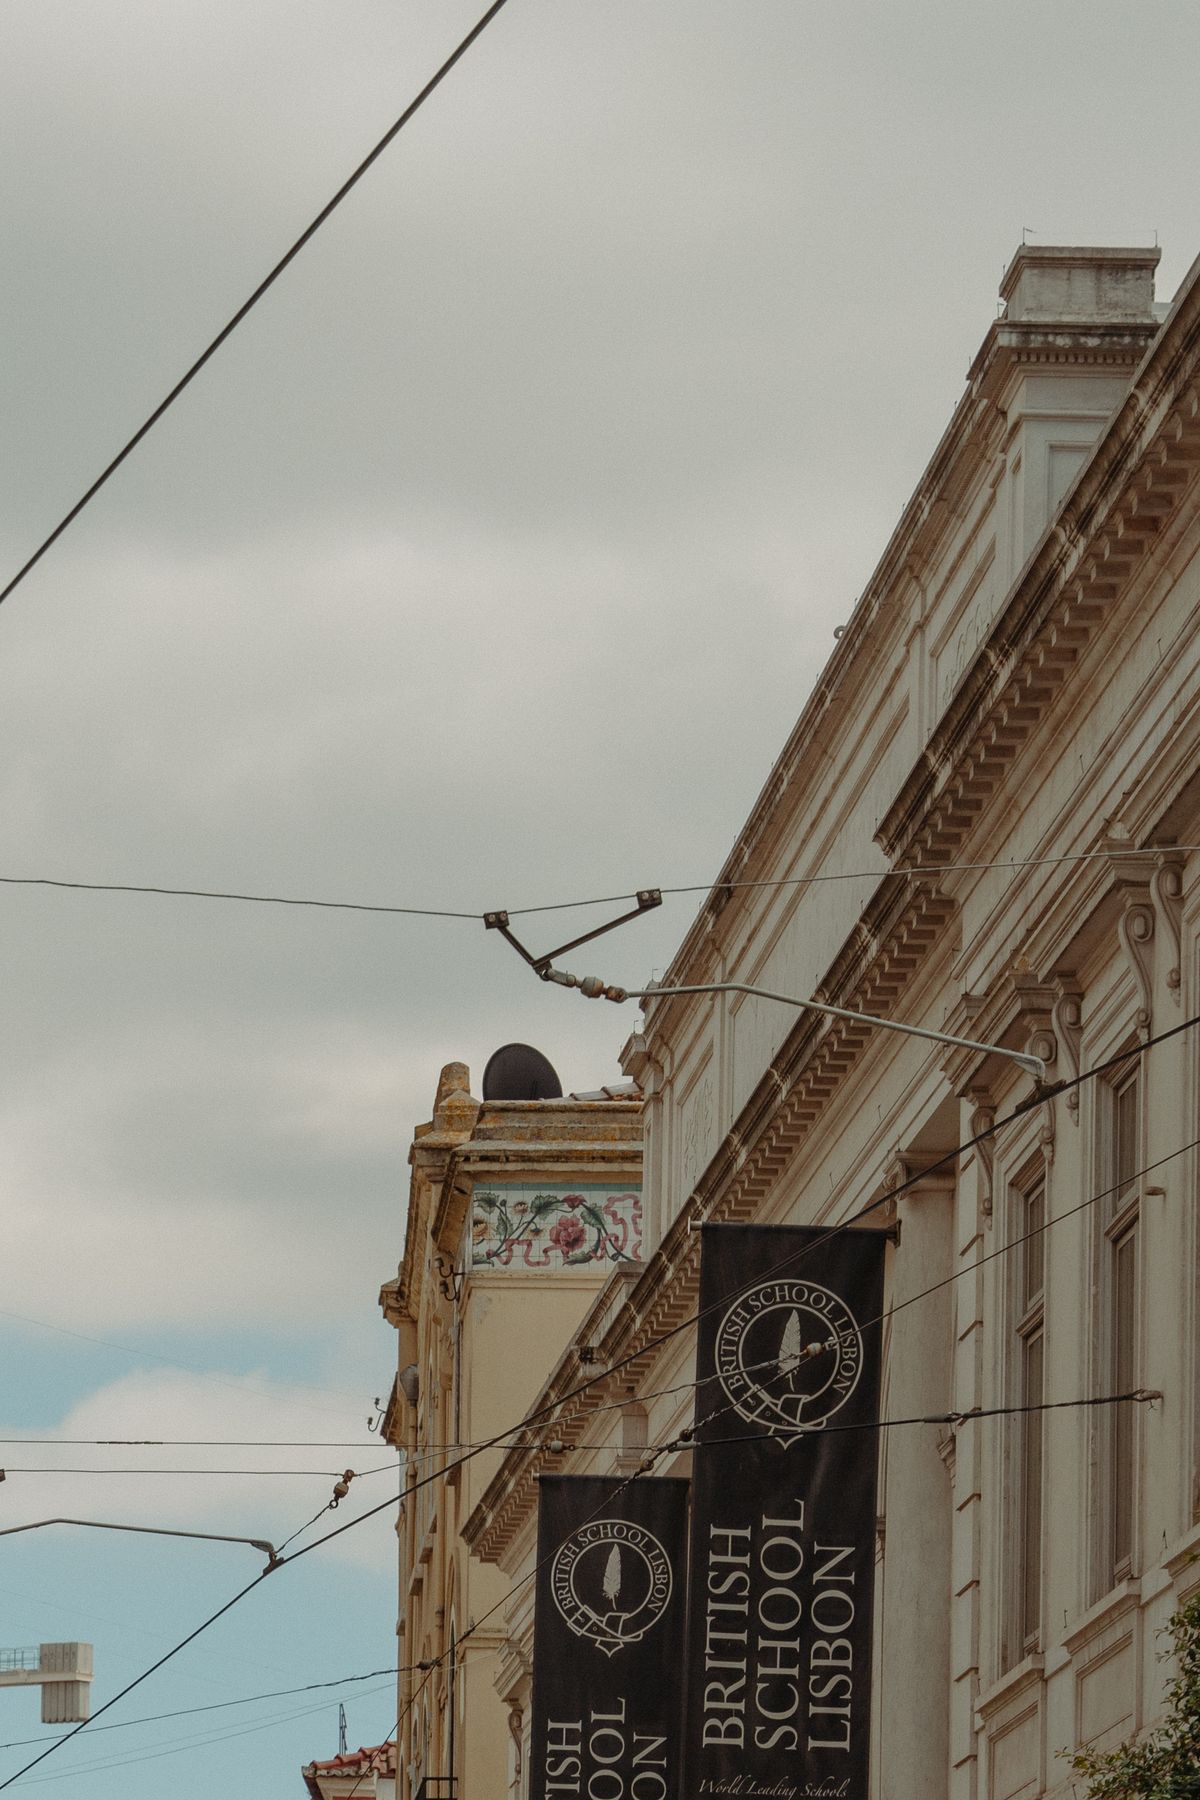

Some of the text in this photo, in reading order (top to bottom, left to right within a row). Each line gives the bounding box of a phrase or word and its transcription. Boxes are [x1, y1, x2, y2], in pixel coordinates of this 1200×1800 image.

[719, 1284, 858, 1396] BRITISH SCHOOL LISBON
[555, 1523, 668, 1614] BRITISH SCHOOL LISBON
[702, 1522, 752, 1750] BRITISH
[754, 1498, 806, 1751] SCHOOL
[807, 1540, 856, 1753] LISBON
[699, 1774, 746, 1795] World
[799, 1775, 851, 1799] Schools
